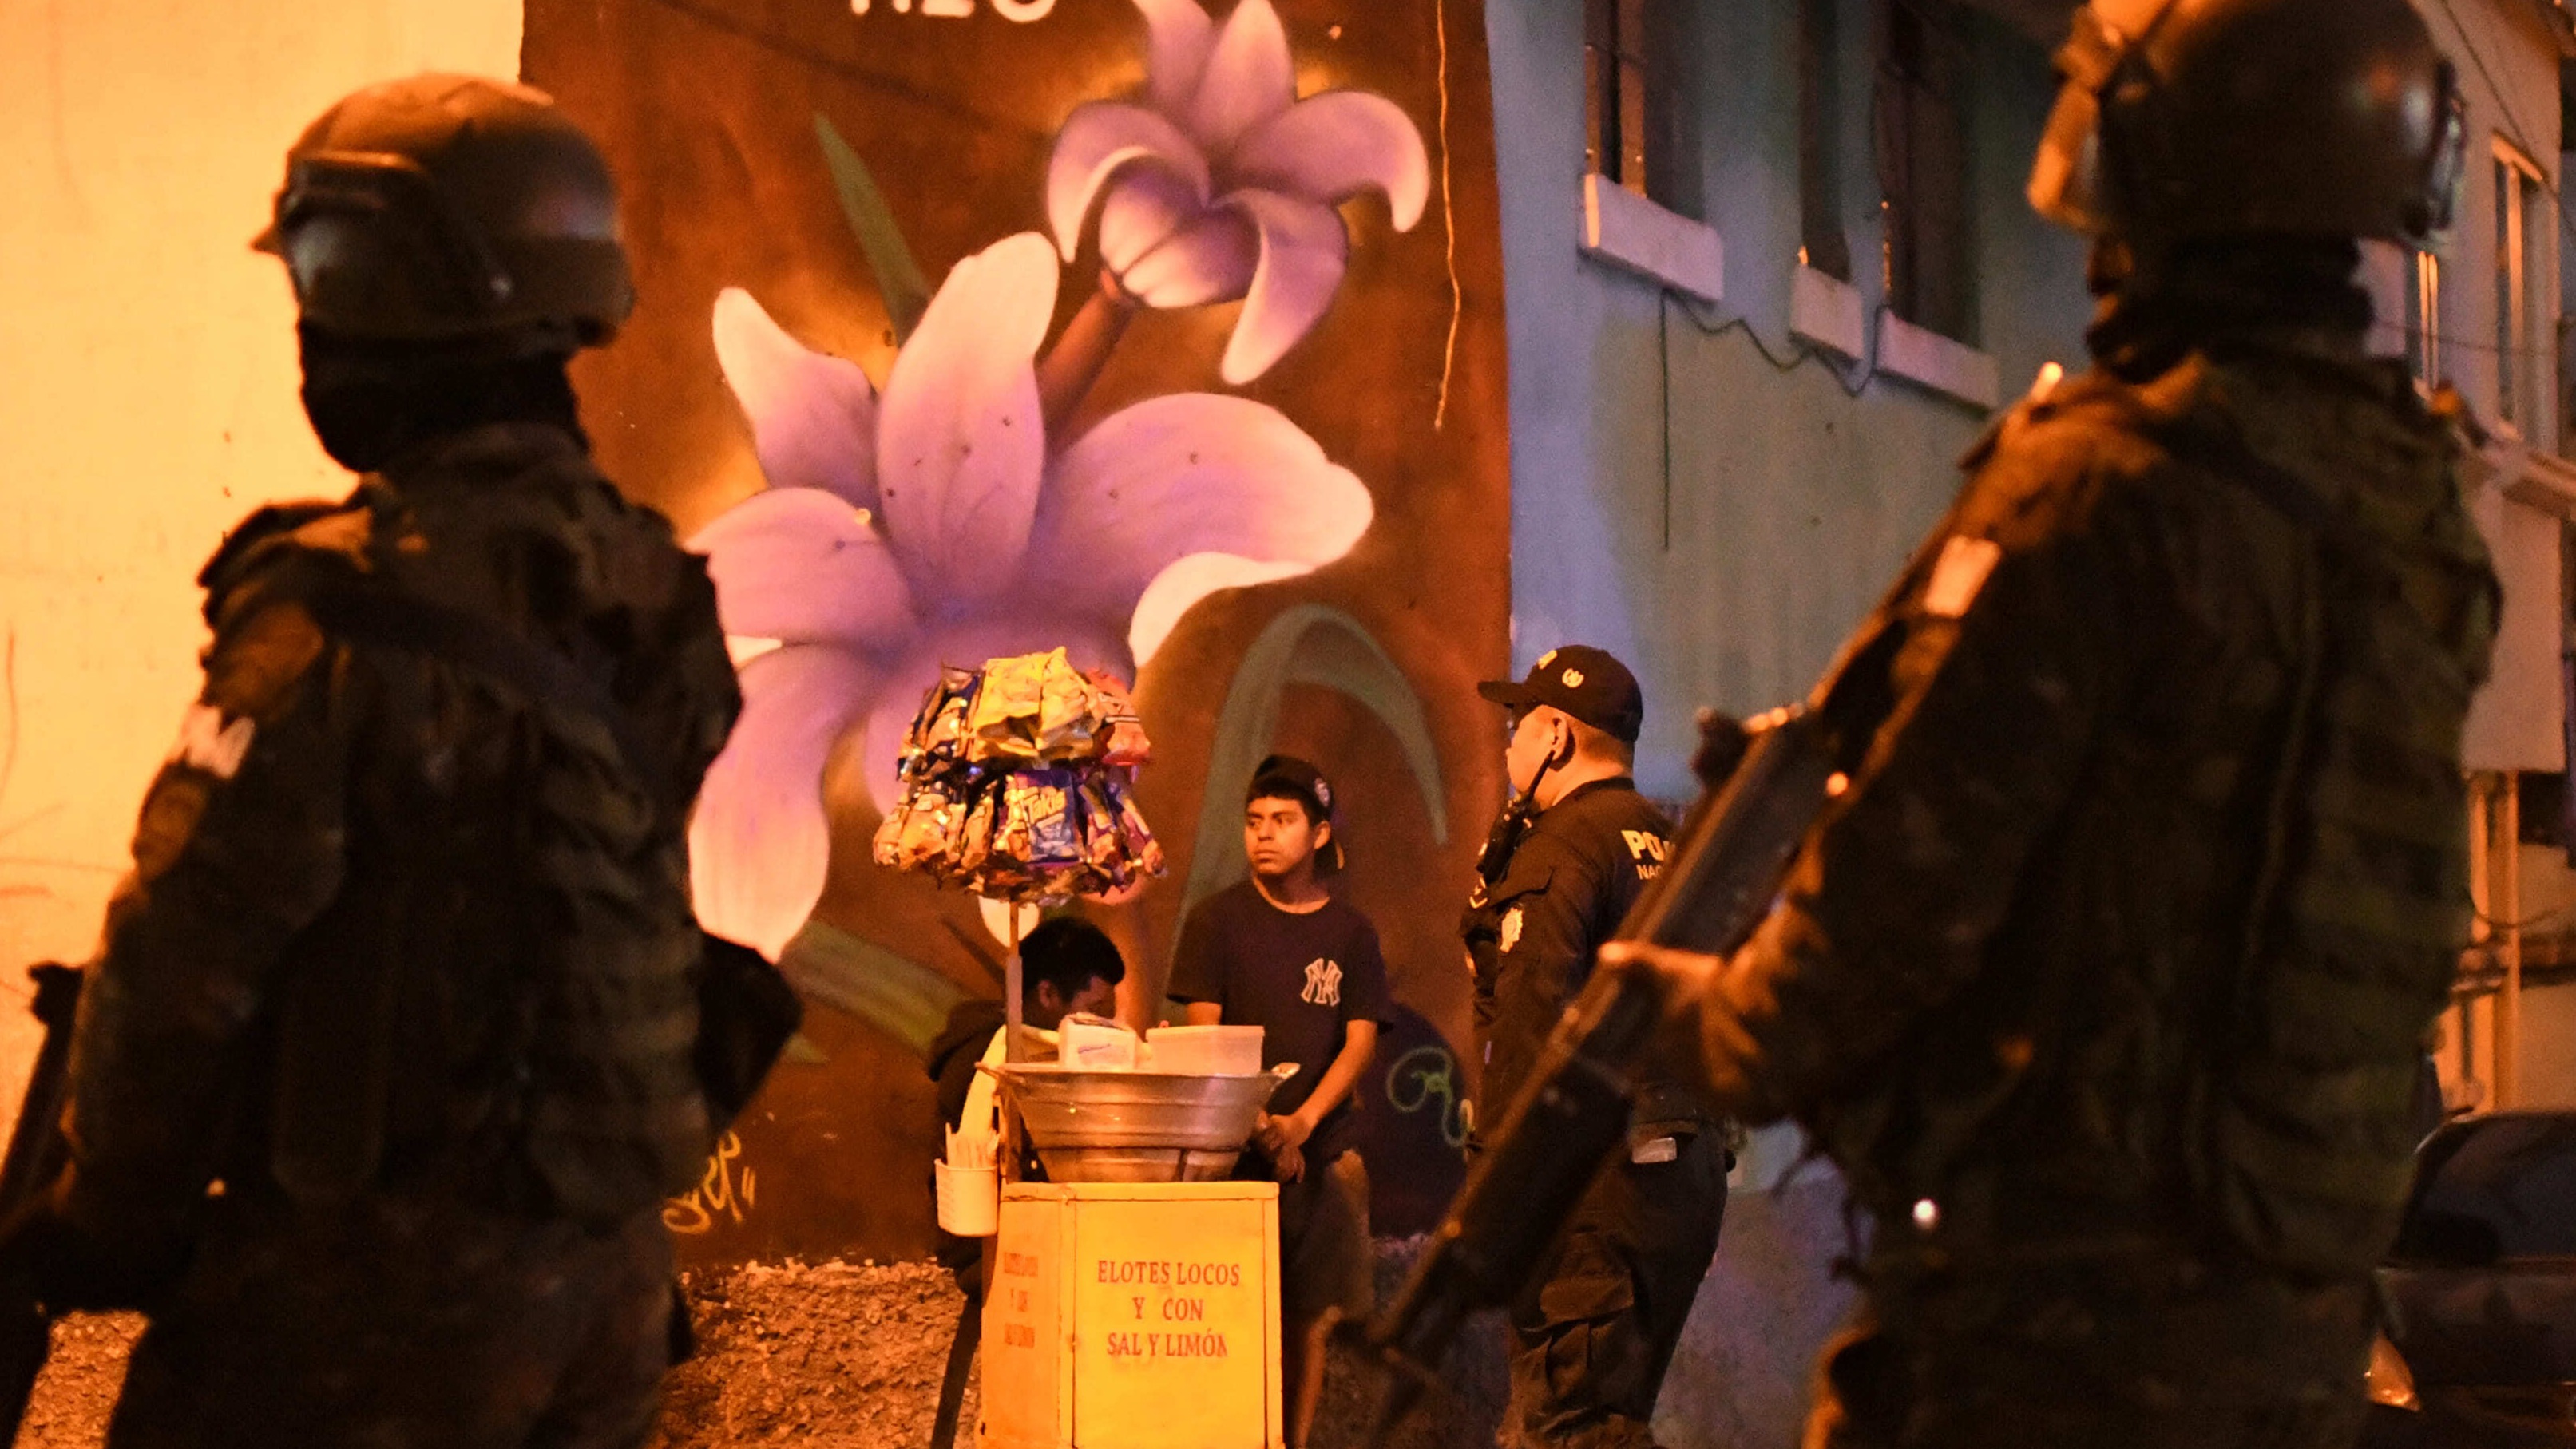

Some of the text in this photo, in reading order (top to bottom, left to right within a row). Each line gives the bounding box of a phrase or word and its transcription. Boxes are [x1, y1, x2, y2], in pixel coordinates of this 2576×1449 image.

[1302, 958, 1342, 1007] NY
[1097, 1260, 1241, 1287] ELOTES LOCOS
[1132, 1297, 1204, 1322] Y CON
[1107, 1328, 1228, 1358] SAL Y LIMÓN
